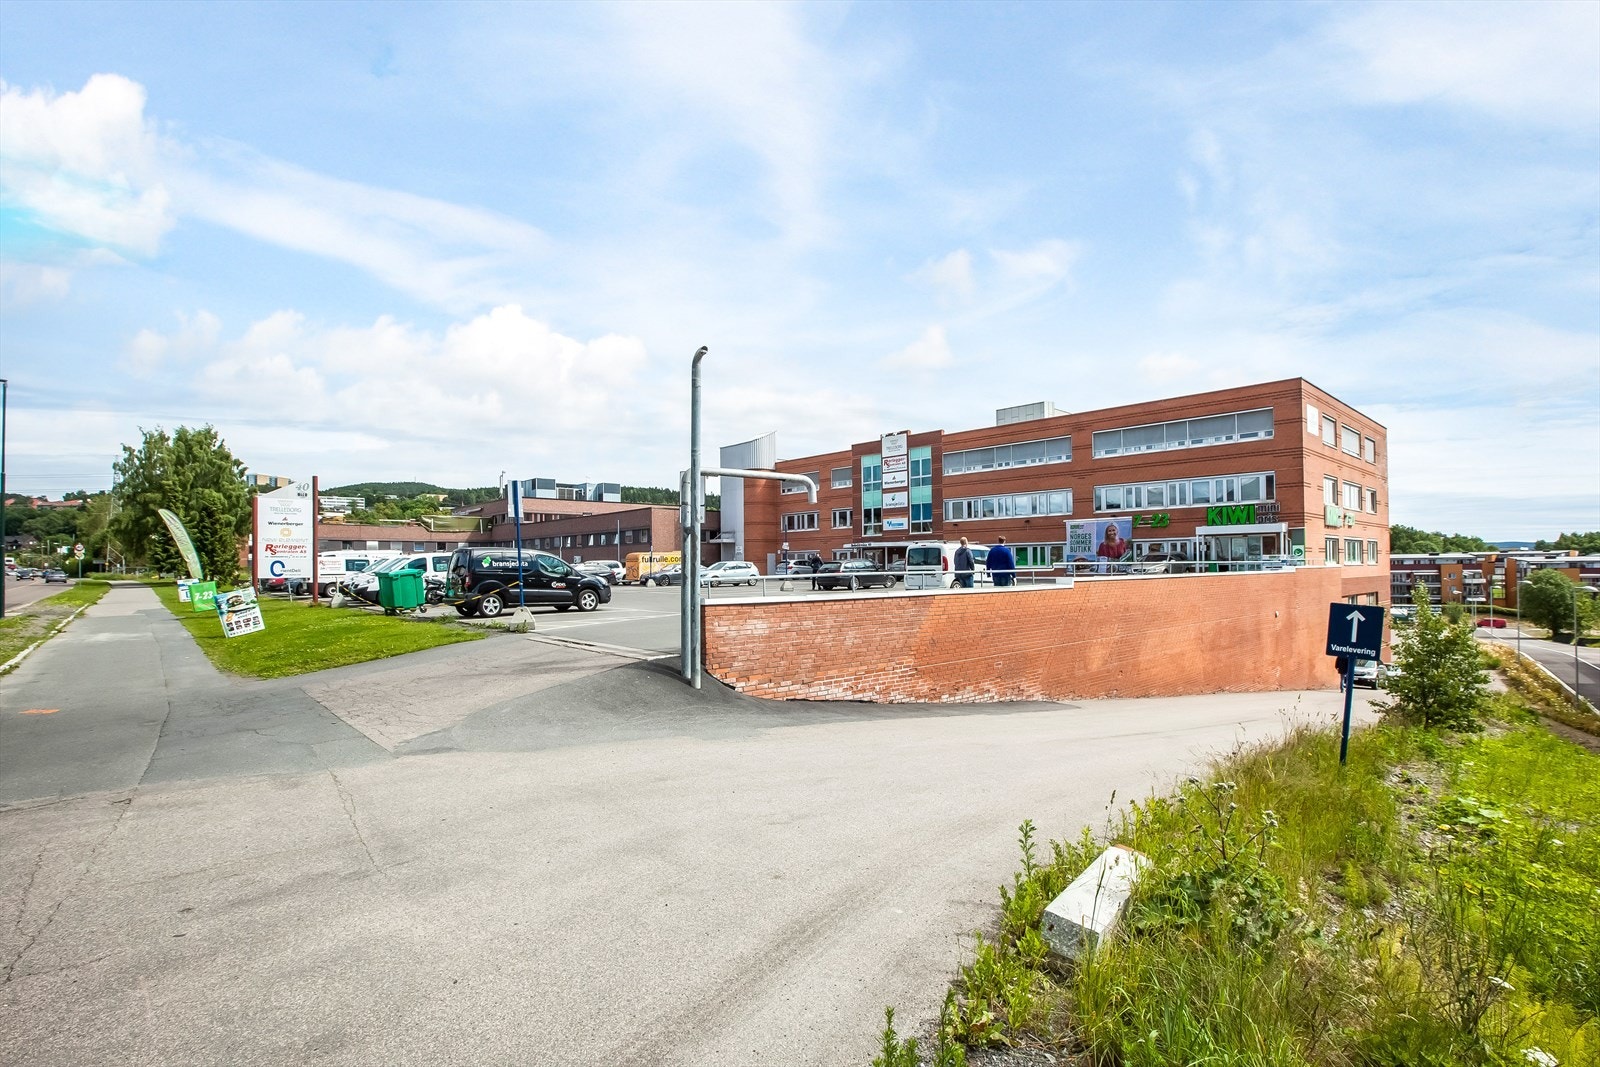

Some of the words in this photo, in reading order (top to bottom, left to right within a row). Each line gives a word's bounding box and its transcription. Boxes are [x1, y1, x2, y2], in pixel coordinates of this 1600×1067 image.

[1207, 504, 1255, 526] KIWI
[1256, 502, 1280, 512] mini
[1257, 513, 1279, 523] pris
[492, 560, 528, 568] bransjedta
[194, 591, 213, 601] 7-23
[1331, 644, 1376, 657] Varelevering
